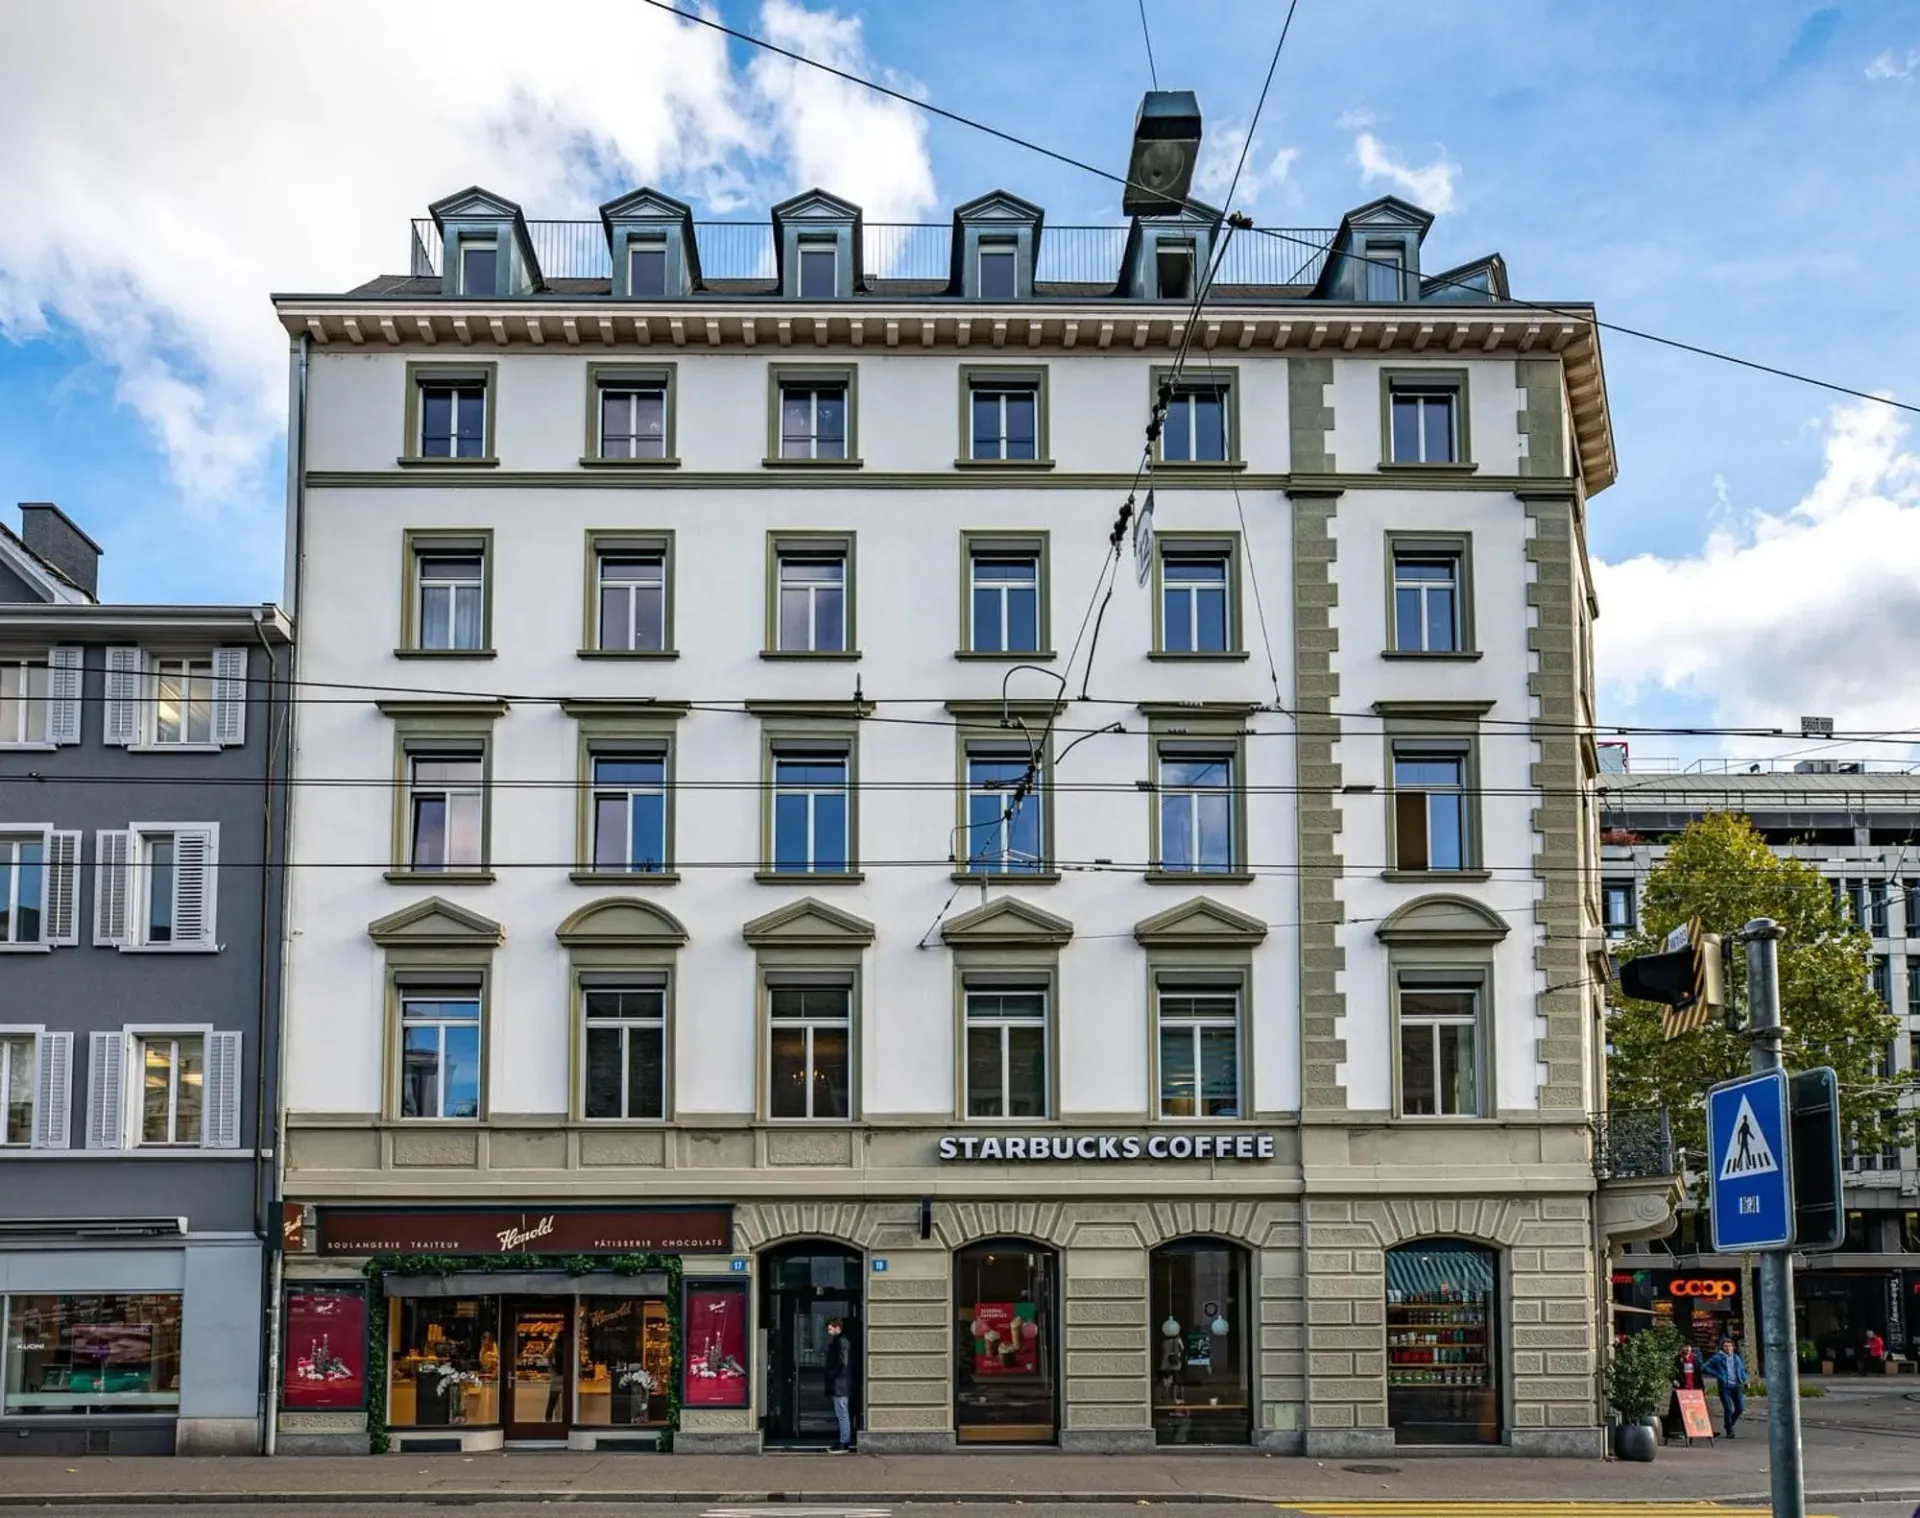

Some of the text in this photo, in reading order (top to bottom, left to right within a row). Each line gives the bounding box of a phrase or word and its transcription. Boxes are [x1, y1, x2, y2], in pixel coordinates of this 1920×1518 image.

[939, 1136, 1276, 1160] STARBUCKS COFFEE
[497, 1215, 554, 1252] Honold
[327, 1241, 460, 1249] BOULANGERIE TRAITEUR
[594, 1236, 723, 1248] PÂTISSERIE CHOCOLATS
[734, 1261, 742, 1270] 17
[1670, 1279, 1737, 1299] coop
